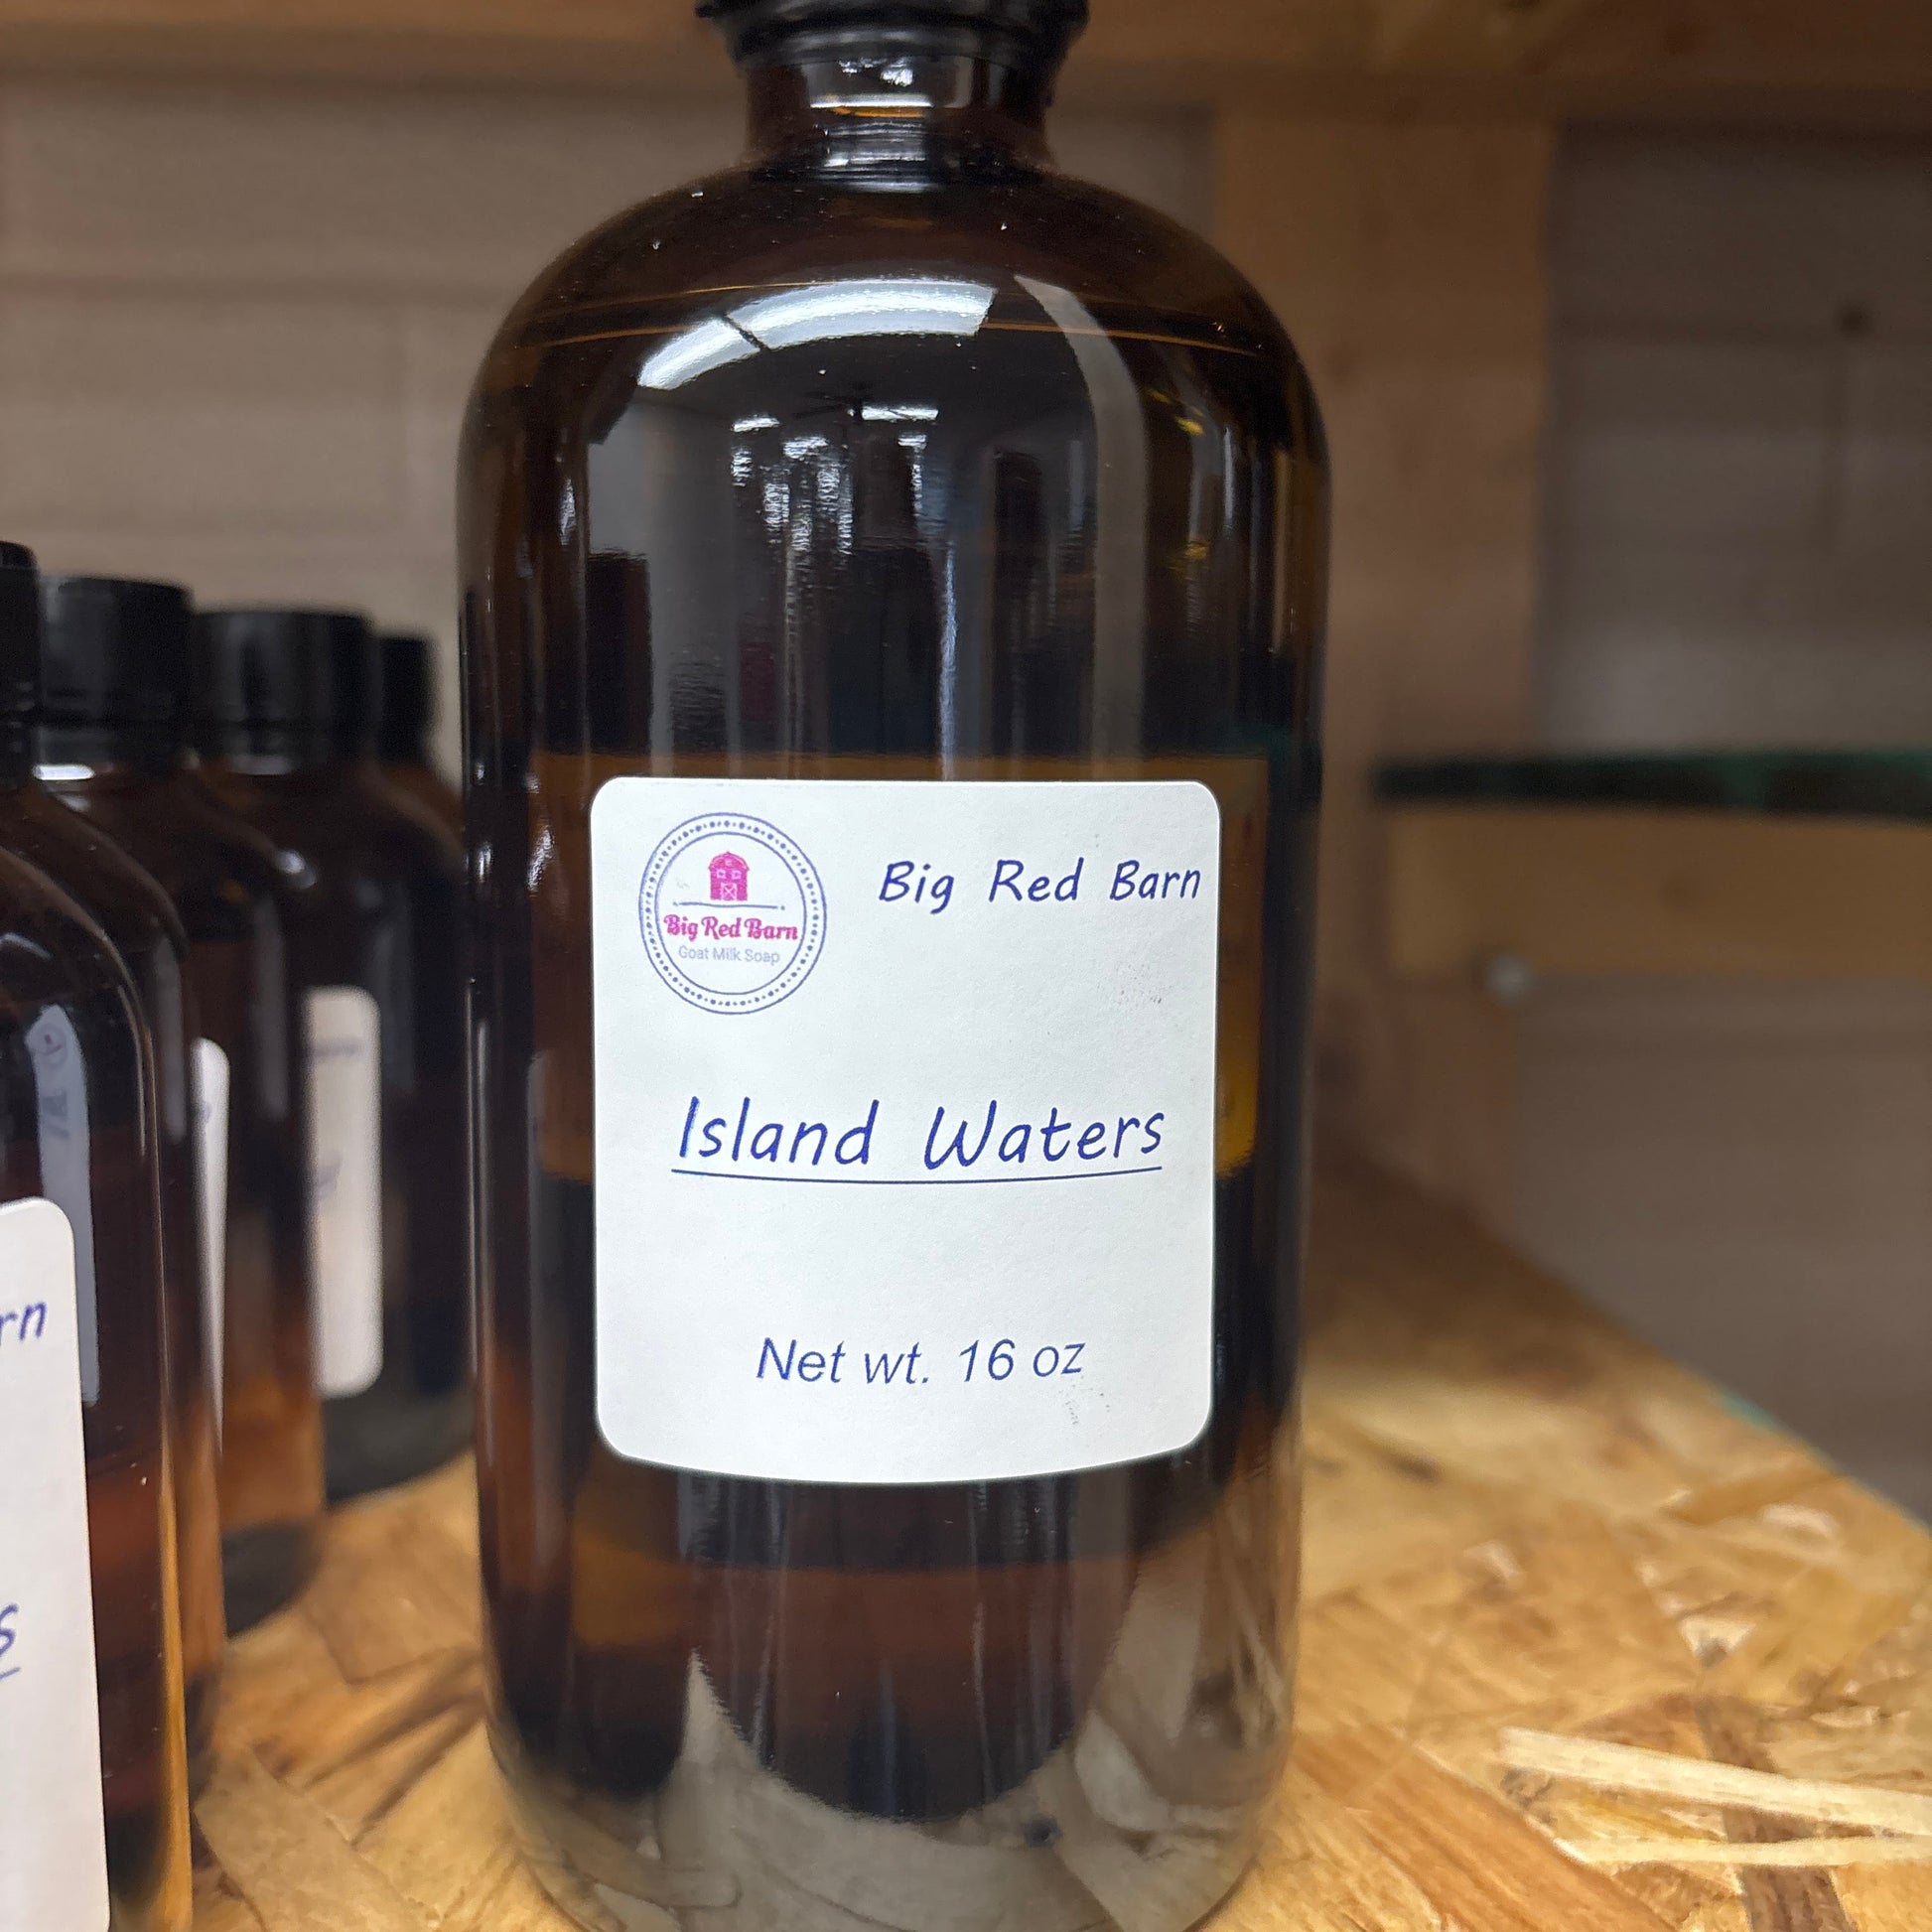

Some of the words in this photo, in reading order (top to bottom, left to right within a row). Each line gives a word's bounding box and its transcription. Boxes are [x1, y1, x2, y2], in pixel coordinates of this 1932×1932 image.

[880, 860, 955, 915] Big
[989, 857, 1085, 902] Red
[1109, 860, 1201, 901] Barn
[663, 914, 699, 942] Big
[701, 916, 742, 941] Red
[744, 918, 799, 941] Barn
[678, 945, 710, 962] Goat
[713, 947, 742, 962] Milk
[744, 949, 780, 967] Soap
[680, 1096, 880, 1168] Island
[924, 1100, 1166, 1172] Waters
[758, 1337, 846, 1384] Net
[865, 1342, 929, 1385] wt.
[959, 1339, 1017, 1383] 16
[1033, 1343, 1087, 1378] oz
